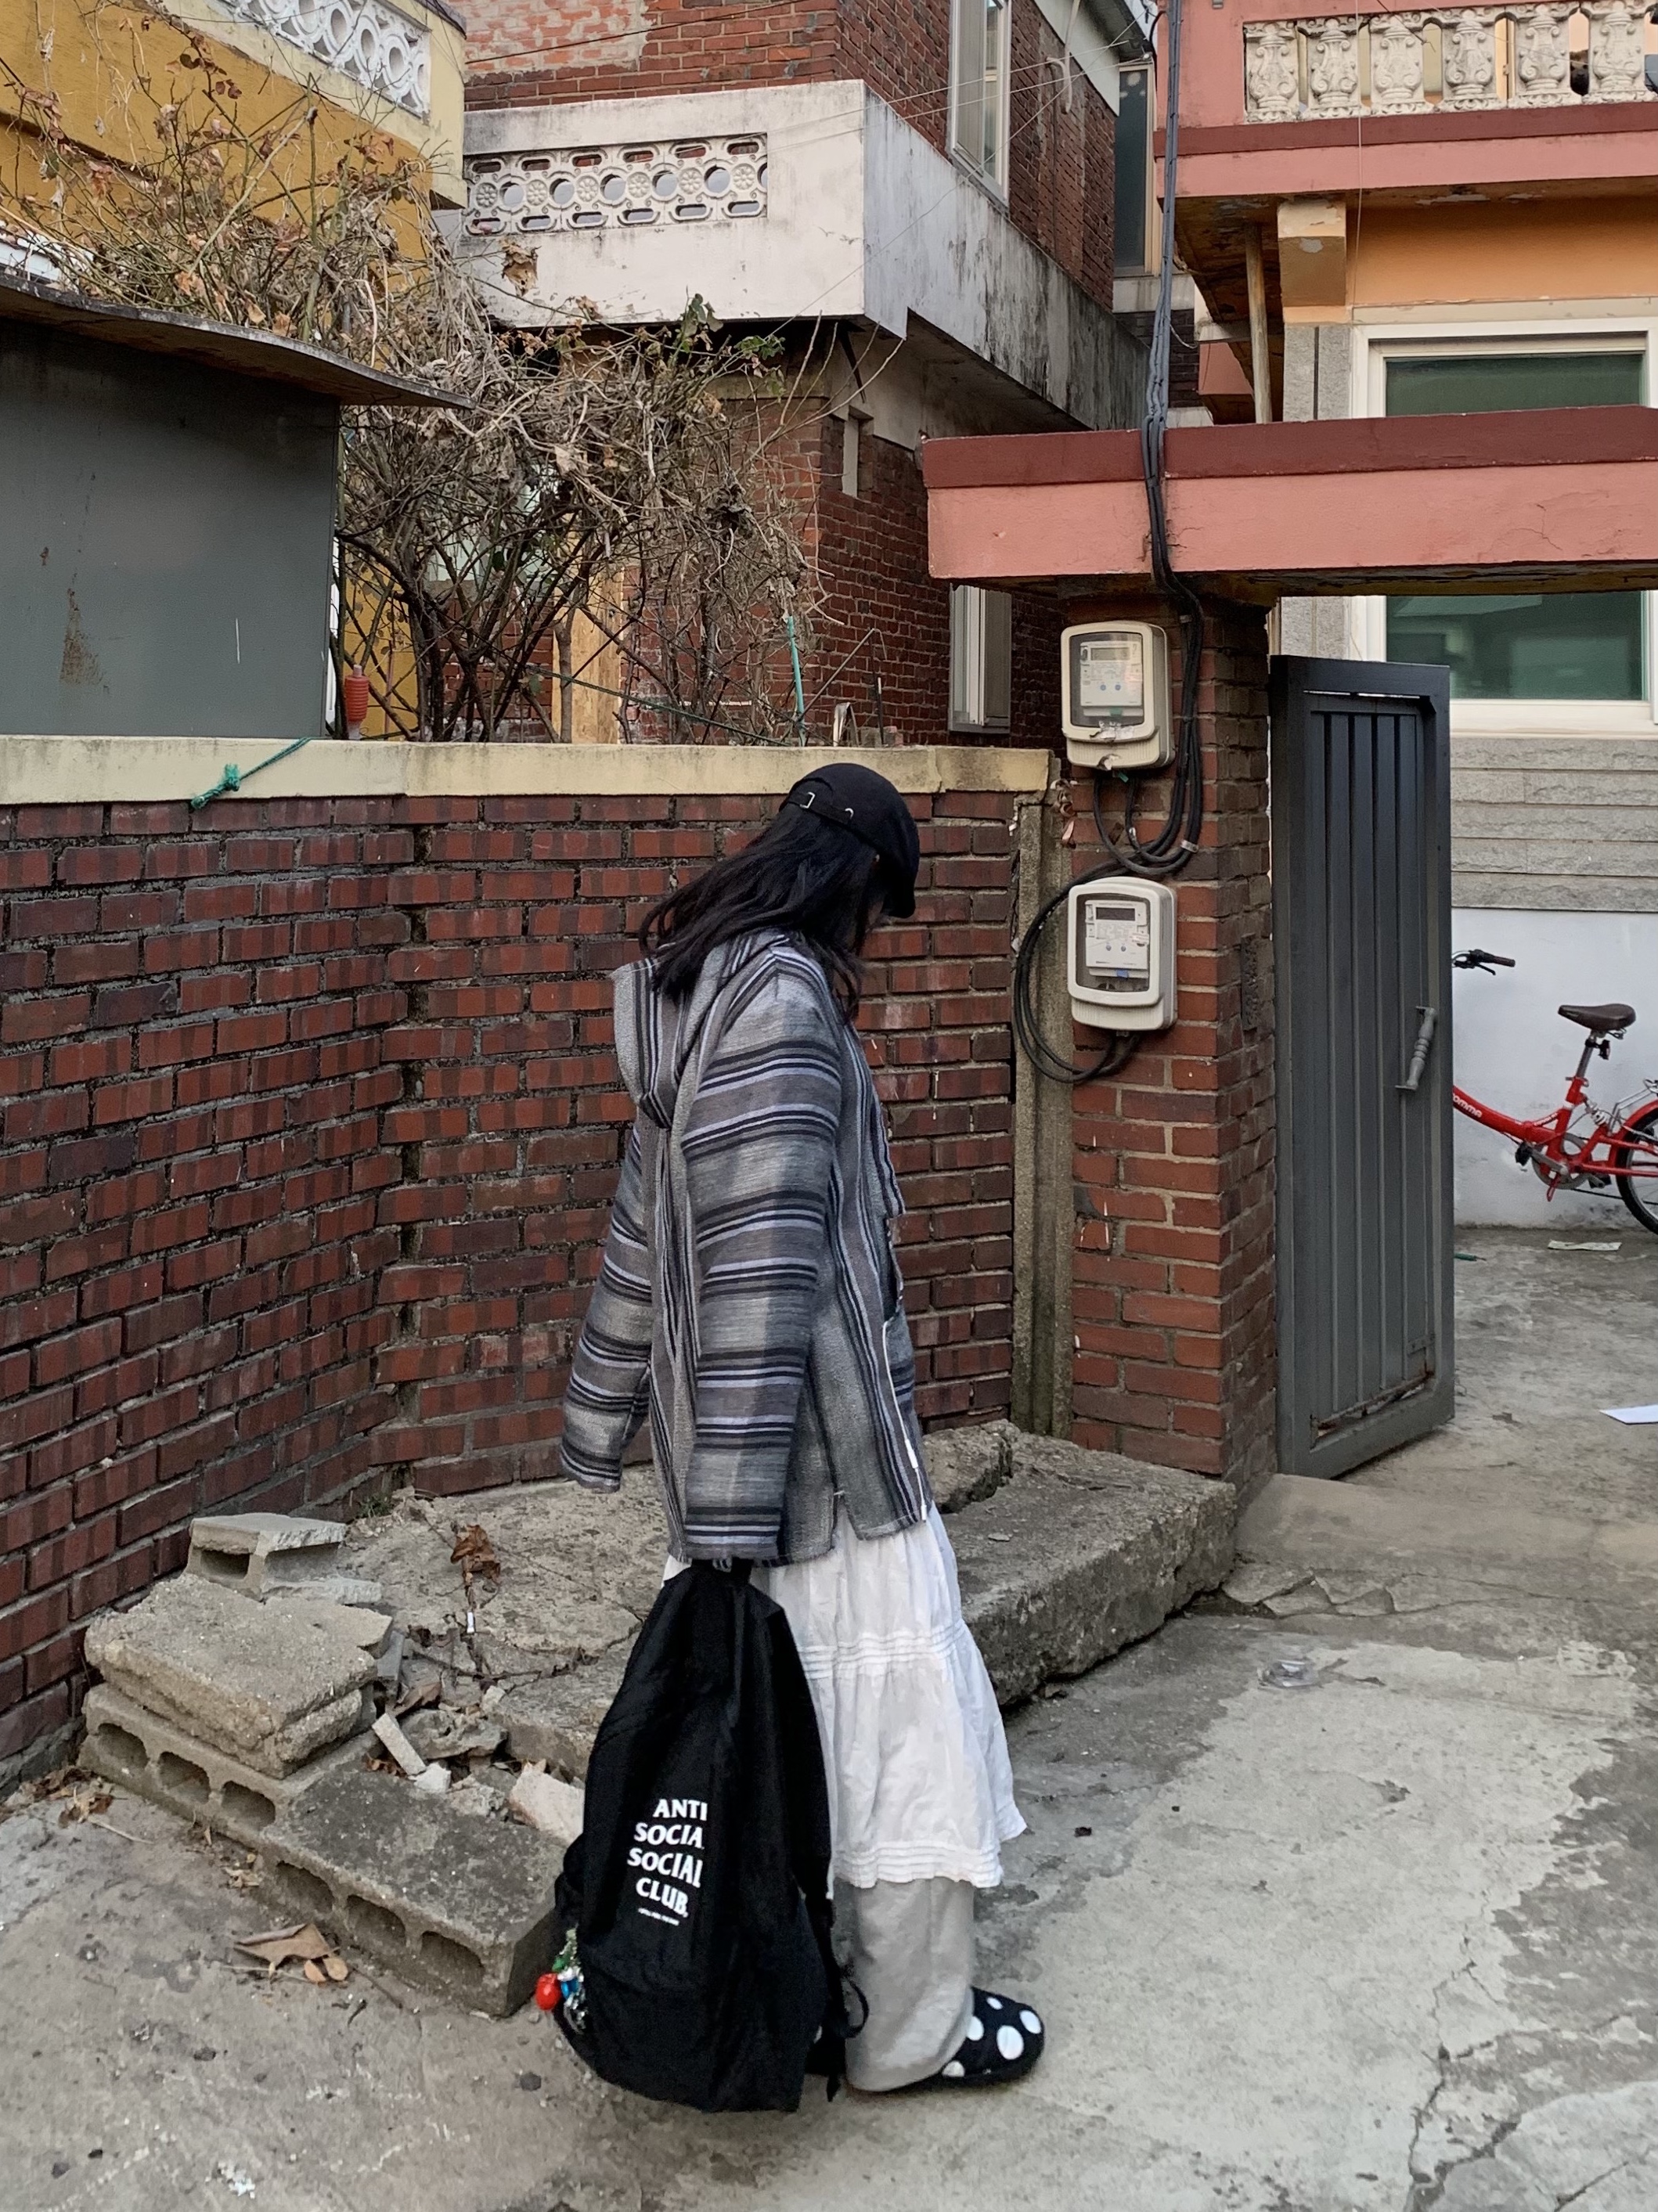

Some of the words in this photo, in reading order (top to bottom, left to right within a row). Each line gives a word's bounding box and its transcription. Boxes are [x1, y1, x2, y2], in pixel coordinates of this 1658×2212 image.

[652, 1798, 708, 1821] ANTI
[633, 1822, 705, 1850] SOCIA
[627, 1847, 703, 1889] SOCIAL
[636, 1877, 689, 1918] CLUB
